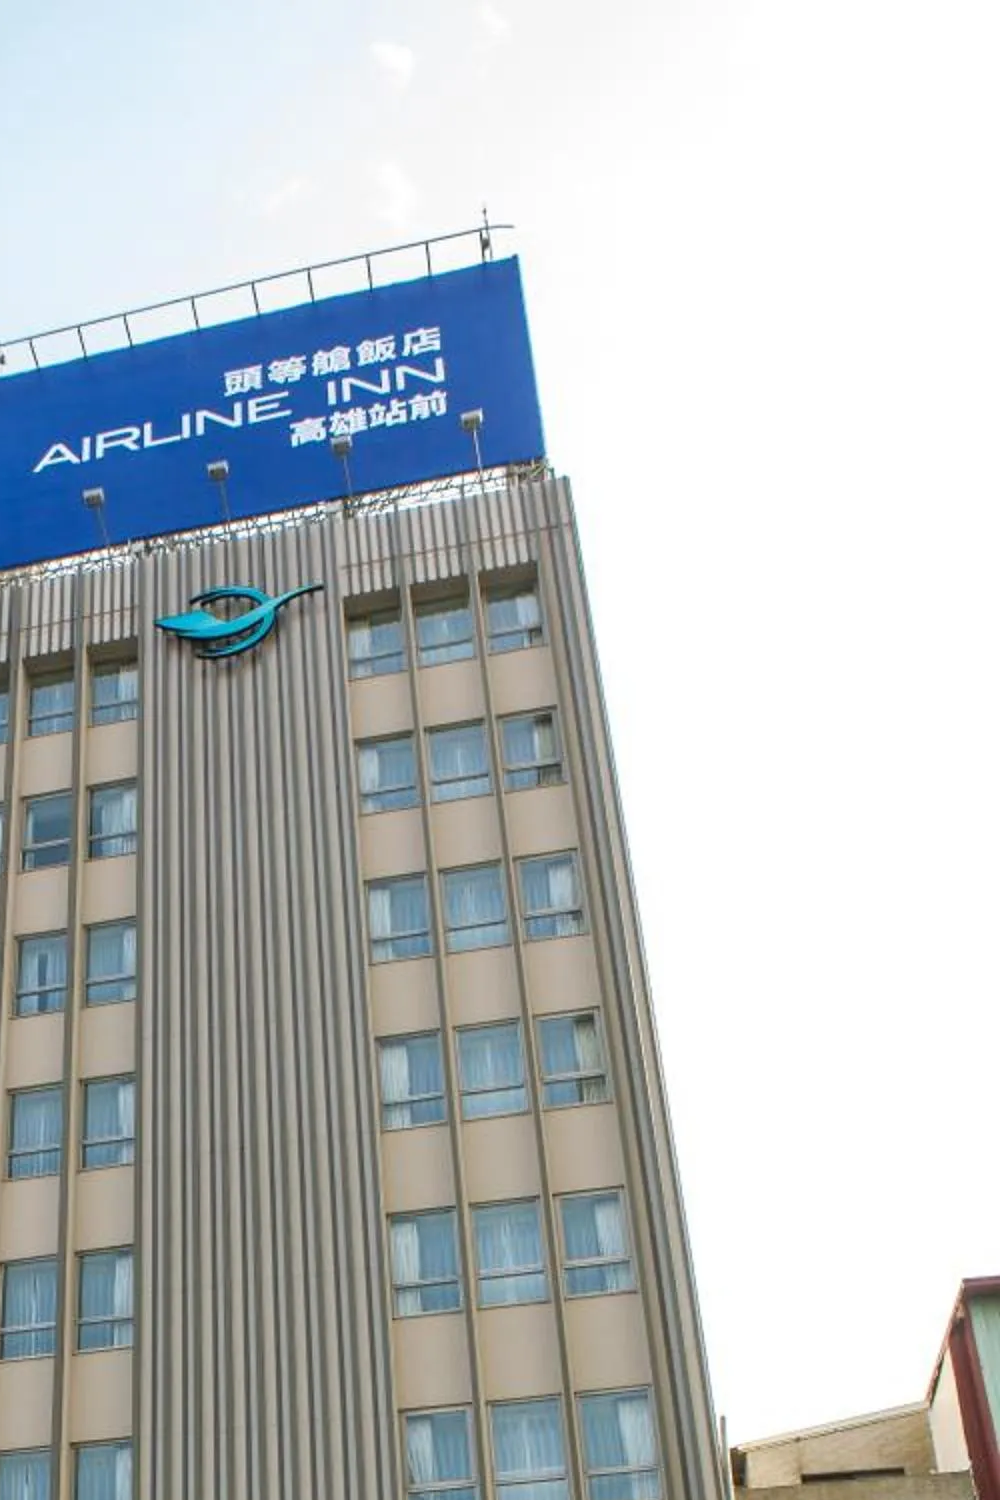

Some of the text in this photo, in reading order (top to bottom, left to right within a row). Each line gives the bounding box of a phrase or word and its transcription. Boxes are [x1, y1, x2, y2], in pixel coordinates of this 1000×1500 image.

[224, 327, 441, 397] 頭等艙飯店
[33, 358, 446, 473] AIRLINE INN
[289, 390, 448, 447] 高雄站前
